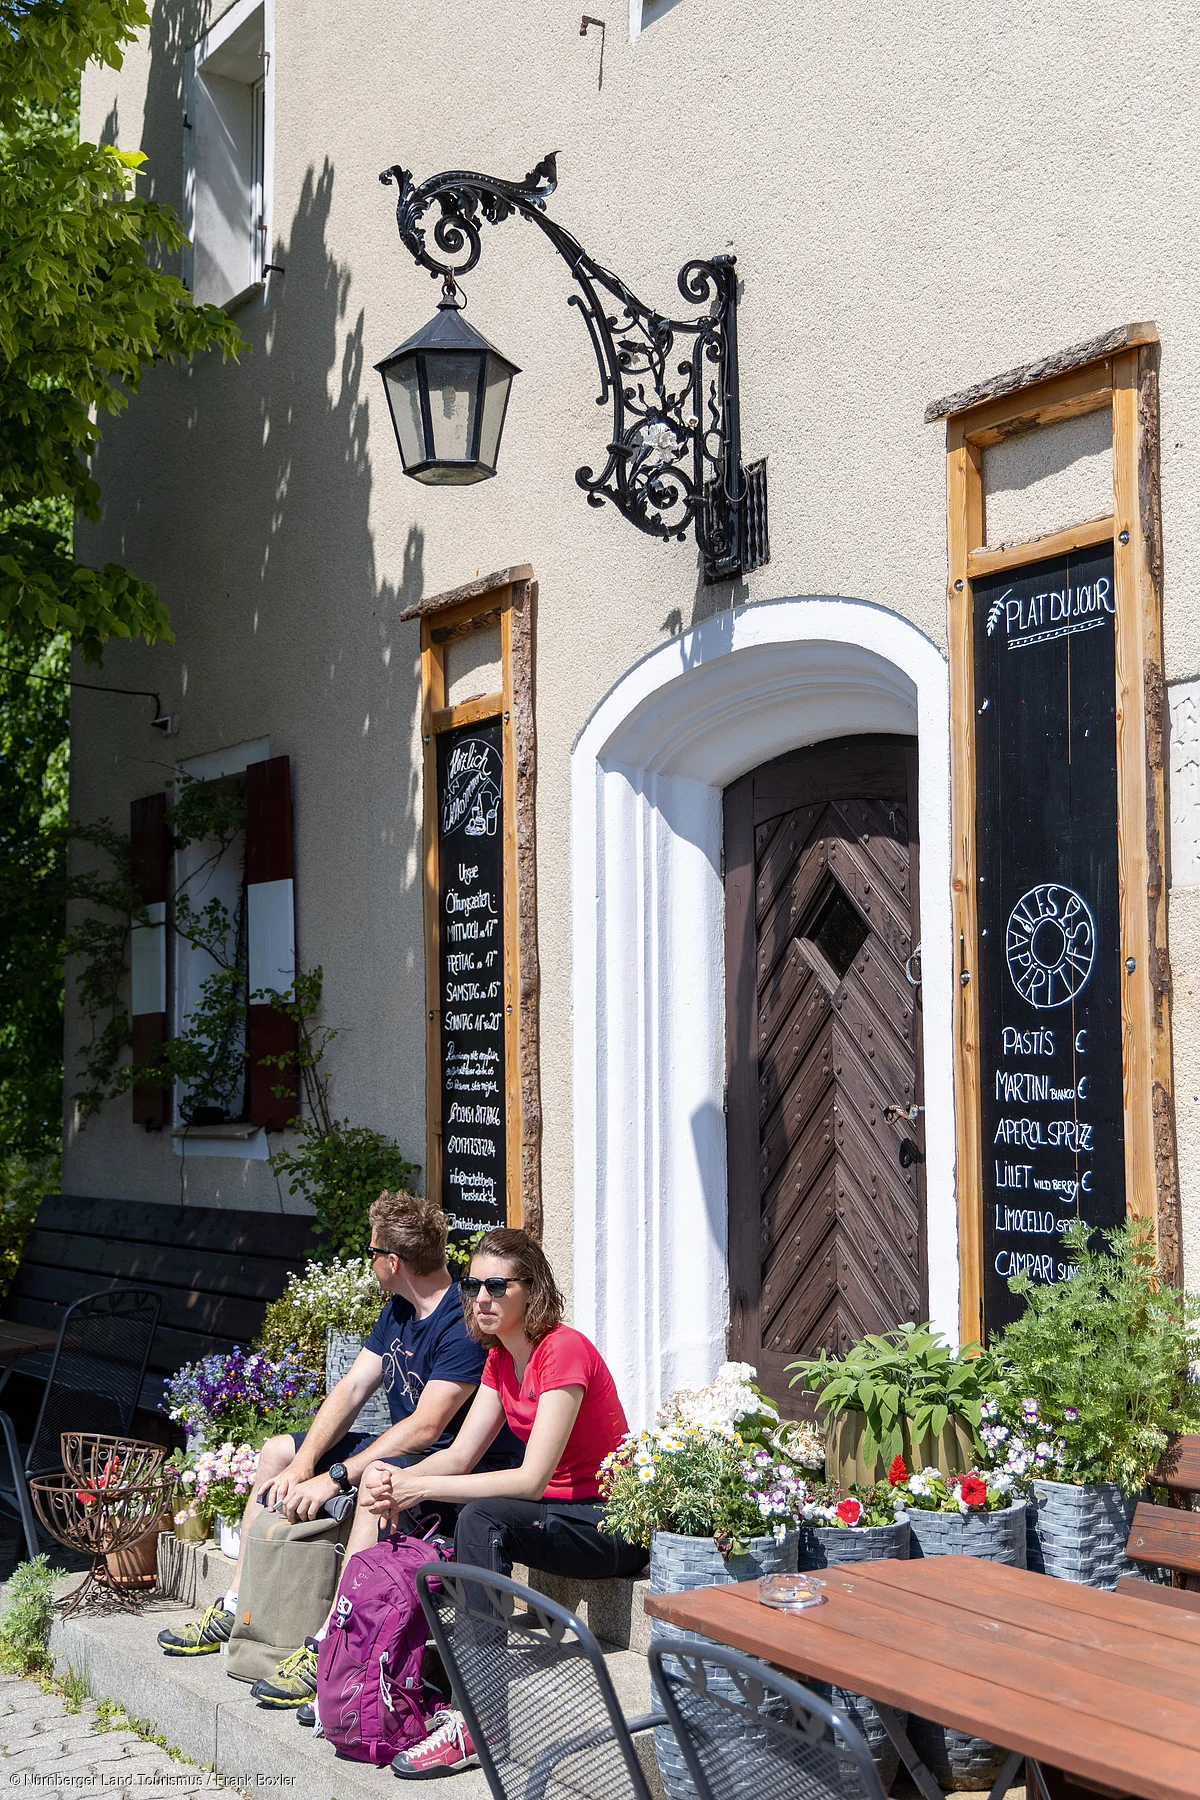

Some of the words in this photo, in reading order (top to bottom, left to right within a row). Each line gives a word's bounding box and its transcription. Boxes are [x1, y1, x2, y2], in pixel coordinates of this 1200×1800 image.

[1005, 594, 1048, 634] PLAT
[1049, 588, 1072, 621] DU
[1072, 577, 1117, 616] JOUR
[1020, 886, 1058, 924] LES
[446, 982, 480, 1003] SAMSTAG
[444, 1010, 474, 1032] SONNTAG
[995, 1069, 1049, 1103] MARTINI
[1049, 1087, 1076, 1102] BIANCO
[993, 1117, 1048, 1150] APEROL
[1032, 1177, 1051, 1191] WILD
[994, 1250, 1056, 1287] CAMPARI
